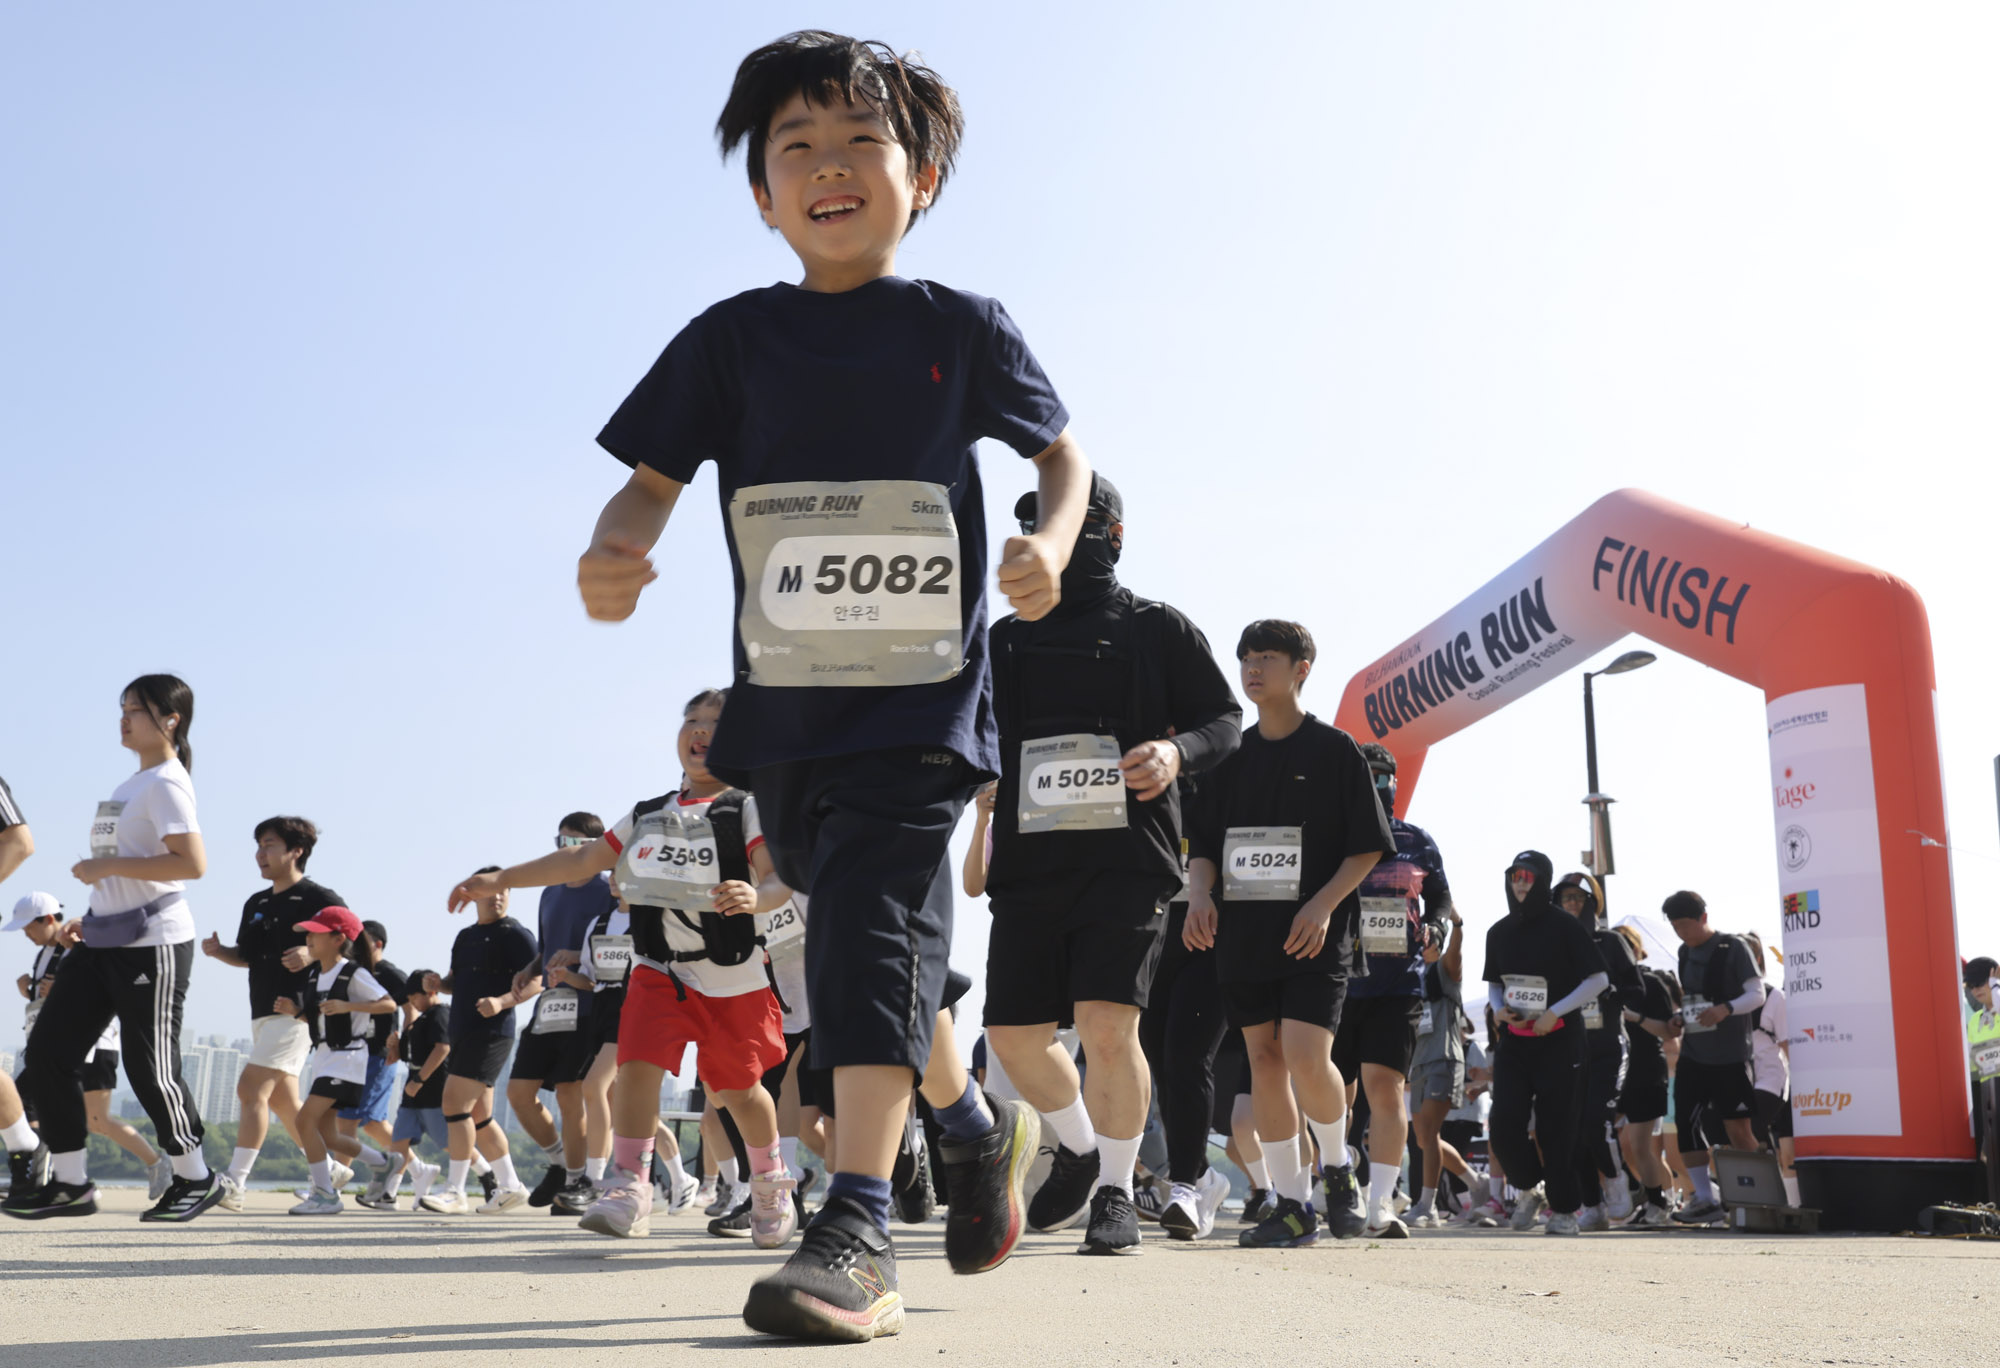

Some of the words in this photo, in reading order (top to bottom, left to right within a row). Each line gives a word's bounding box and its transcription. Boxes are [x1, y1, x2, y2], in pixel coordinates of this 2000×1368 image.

[744, 496, 818, 517] BURNING
[820, 495, 863, 511] RUN
[911, 500, 944, 514] 5km
[777, 565, 803, 593] M
[814, 554, 953, 595] 5082
[1593, 536, 1752, 645] FINISH
[833, 606, 880, 621] 안우진
[1364, 630, 1485, 739] BURNING
[1480, 576, 1558, 669] RUN
[1467, 676, 1500, 701] Casual
[1498, 658, 1541, 687] Running
[1532, 634, 1576, 670] Festival
[1037, 775, 1051, 789] M
[1058, 768, 1120, 788] 5025
[1236, 857, 1246, 867] M
[1250, 853, 1297, 867] 5024
[1369, 917, 1404, 928] 5093
[1784, 910, 1821, 933] KIND
[1789, 951, 1817, 967] TOUS
[1515, 991, 1544, 1001] 5626
[548, 1003, 575, 1013] 5242
